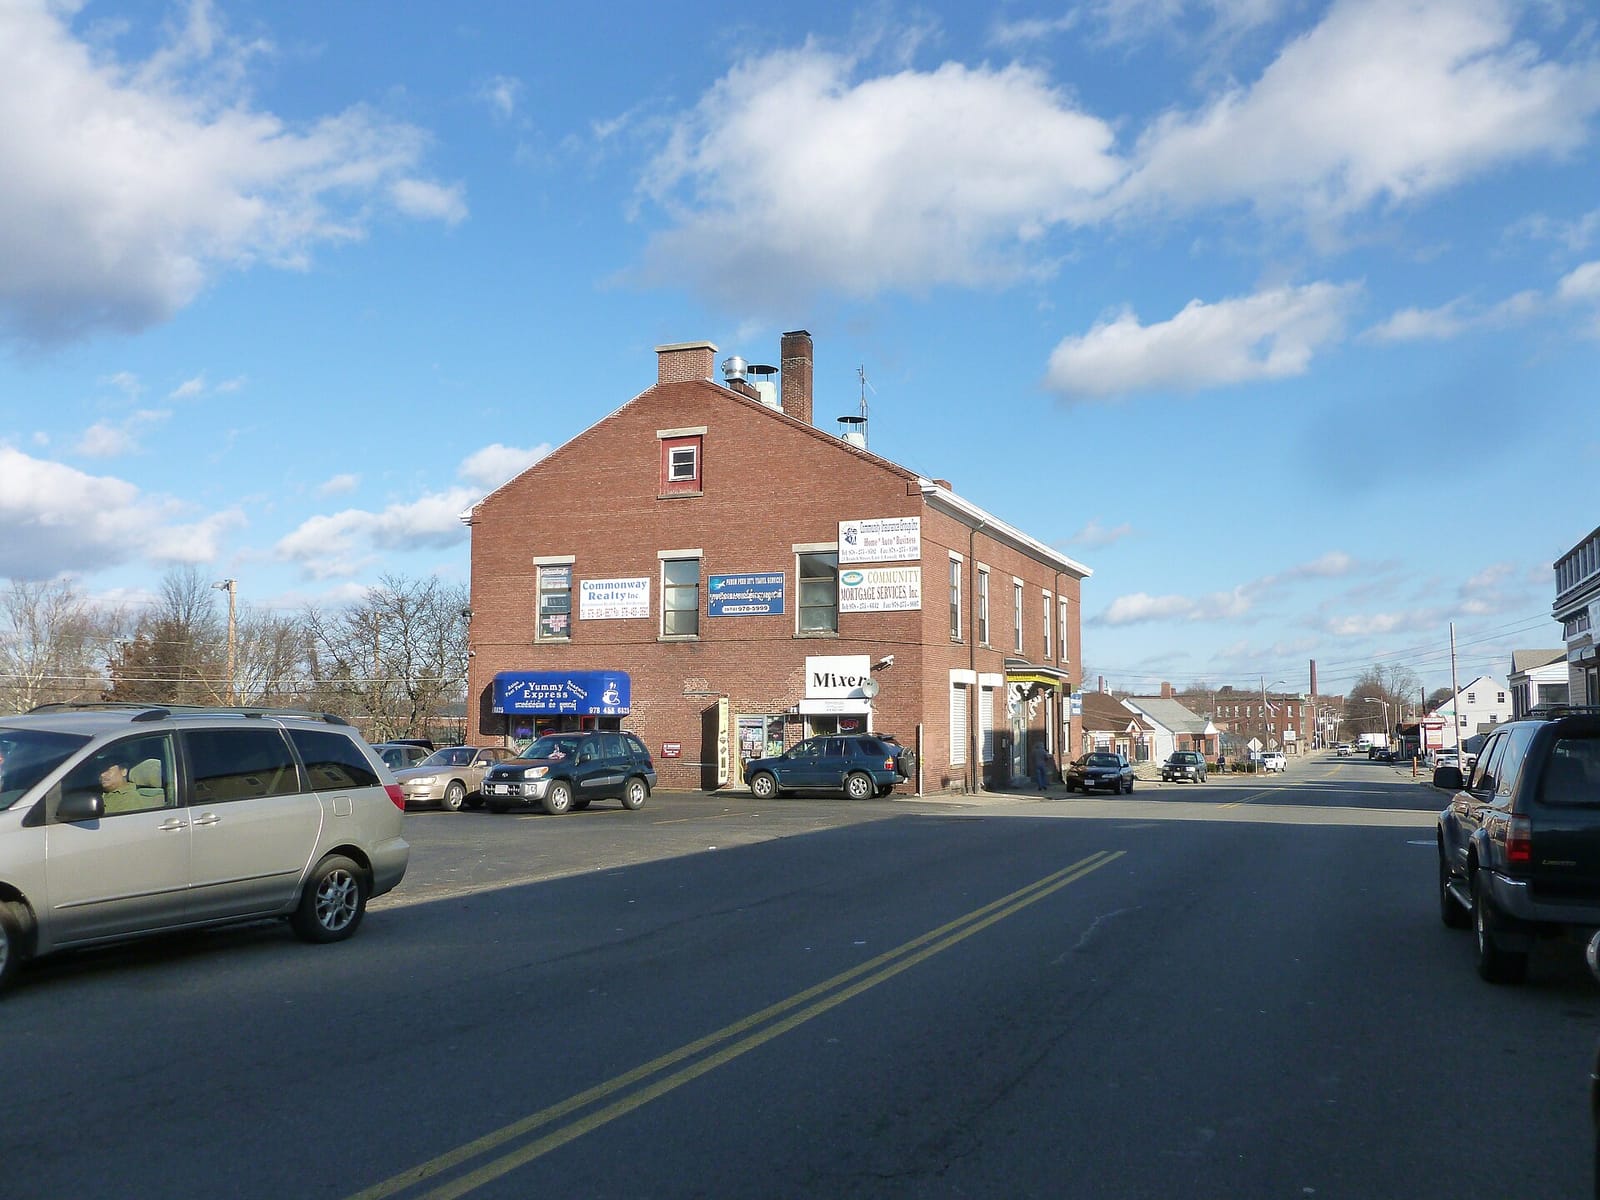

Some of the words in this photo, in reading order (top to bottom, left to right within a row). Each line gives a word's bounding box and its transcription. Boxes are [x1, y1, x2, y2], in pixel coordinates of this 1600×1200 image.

[867, 570, 920, 584] COMMUNITY
[582, 580, 648, 591] Commonway
[588, 591, 627, 602] Realty
[840, 586, 876, 601] MORTGAGE
[813, 672, 867, 688] Mixer
[528, 682, 564, 692] Yummy
[523, 690, 569, 700] Express
